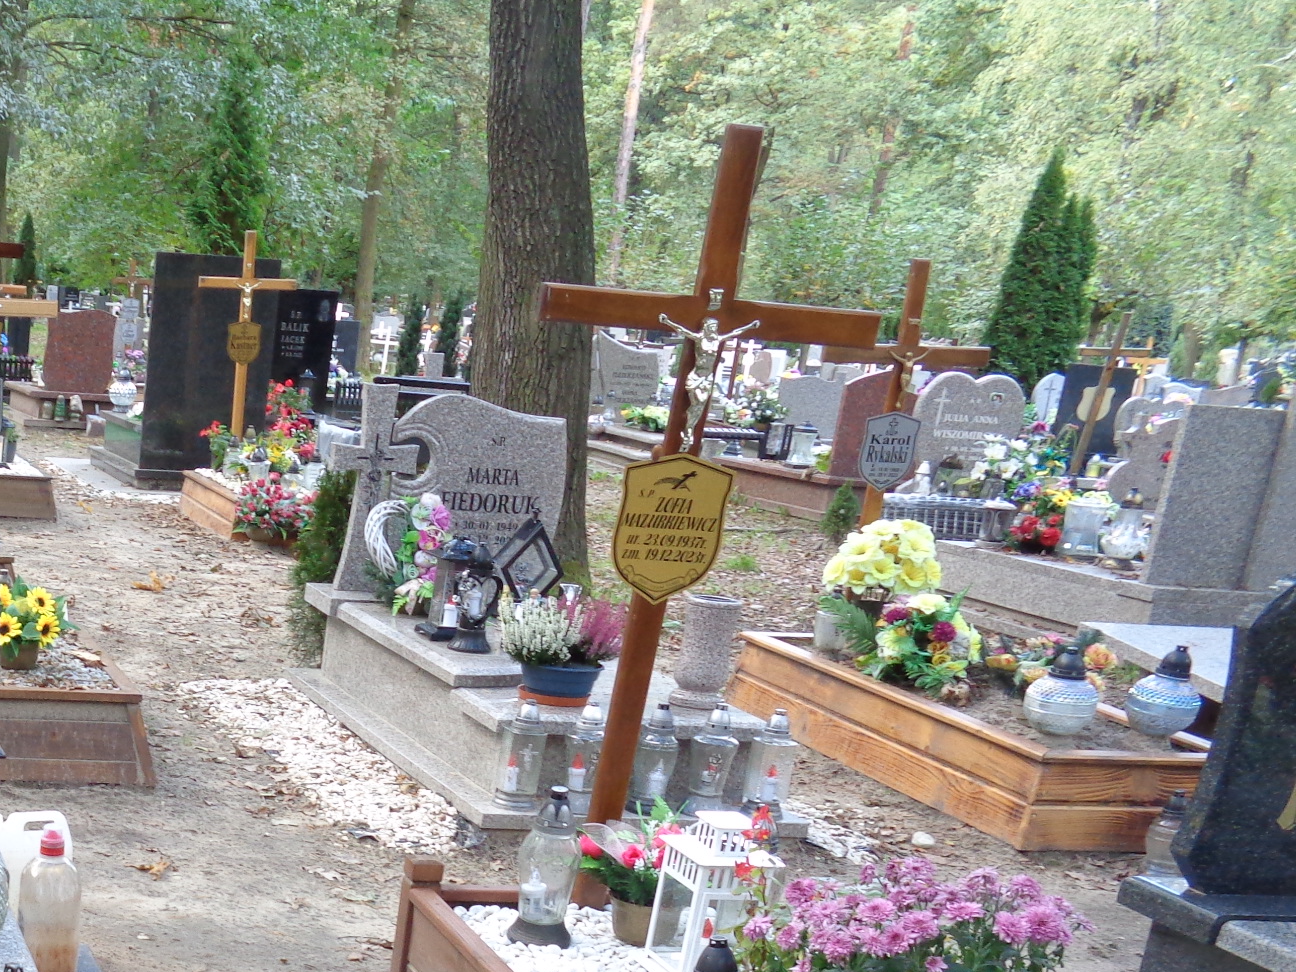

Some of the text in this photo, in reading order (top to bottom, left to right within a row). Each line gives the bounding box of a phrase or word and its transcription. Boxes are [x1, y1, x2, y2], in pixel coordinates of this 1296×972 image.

[943, 413, 999, 424] JULIA ANNA
[870, 434, 911, 445] Karol
[866, 445, 909, 463] Rykalski
[466, 467, 519, 486] MARTA
[442, 491, 542, 514] FIEDORUK
[655, 496, 694, 514] ZOFIA
[622, 512, 719, 533] MAZURKIEWICZ
[626, 534, 640, 545] ur.
[621, 549, 640, 559] zm.
